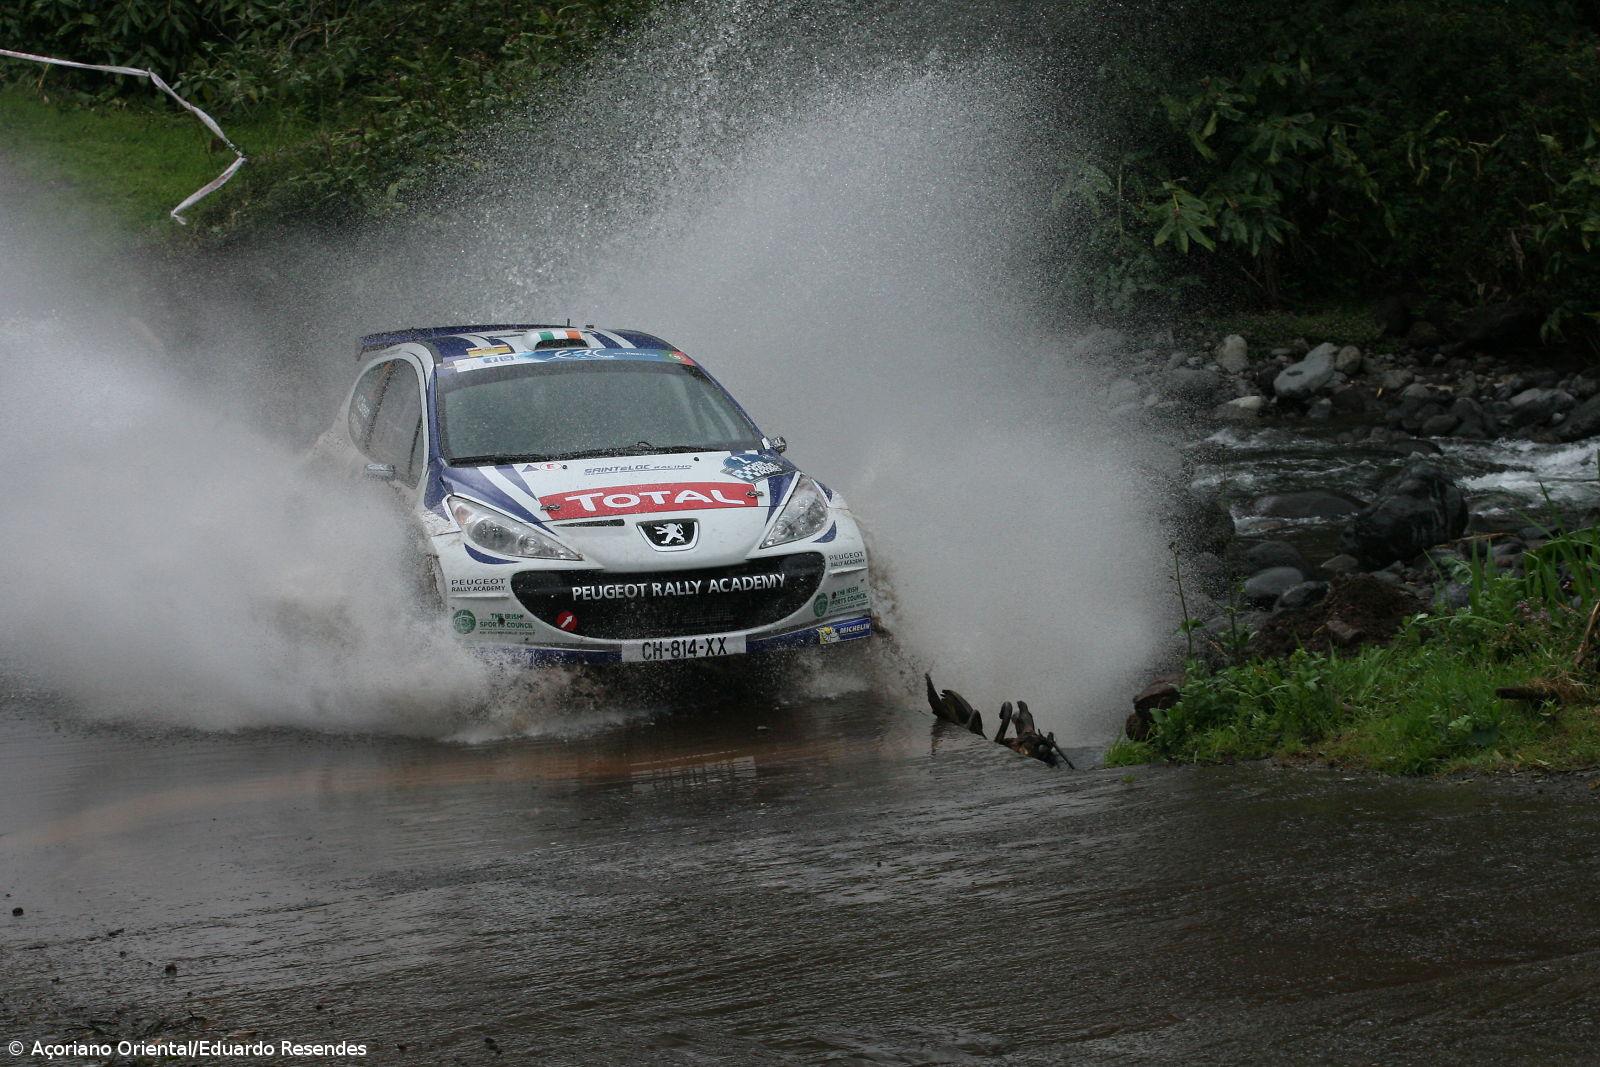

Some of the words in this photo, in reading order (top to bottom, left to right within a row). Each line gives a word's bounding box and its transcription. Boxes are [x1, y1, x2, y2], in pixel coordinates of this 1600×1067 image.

[565, 489, 745, 512] TOTAL
[828, 551, 863, 560] PEUGEOT
[451, 578, 506, 586] PEUGEOT
[572, 583, 647, 601] PEUGEOT
[652, 580, 701, 597] RALLY
[708, 573, 785, 594] ACADEMY
[840, 622, 871, 634] MICHELIN
[642, 636, 727, 661] CH-814-XX
